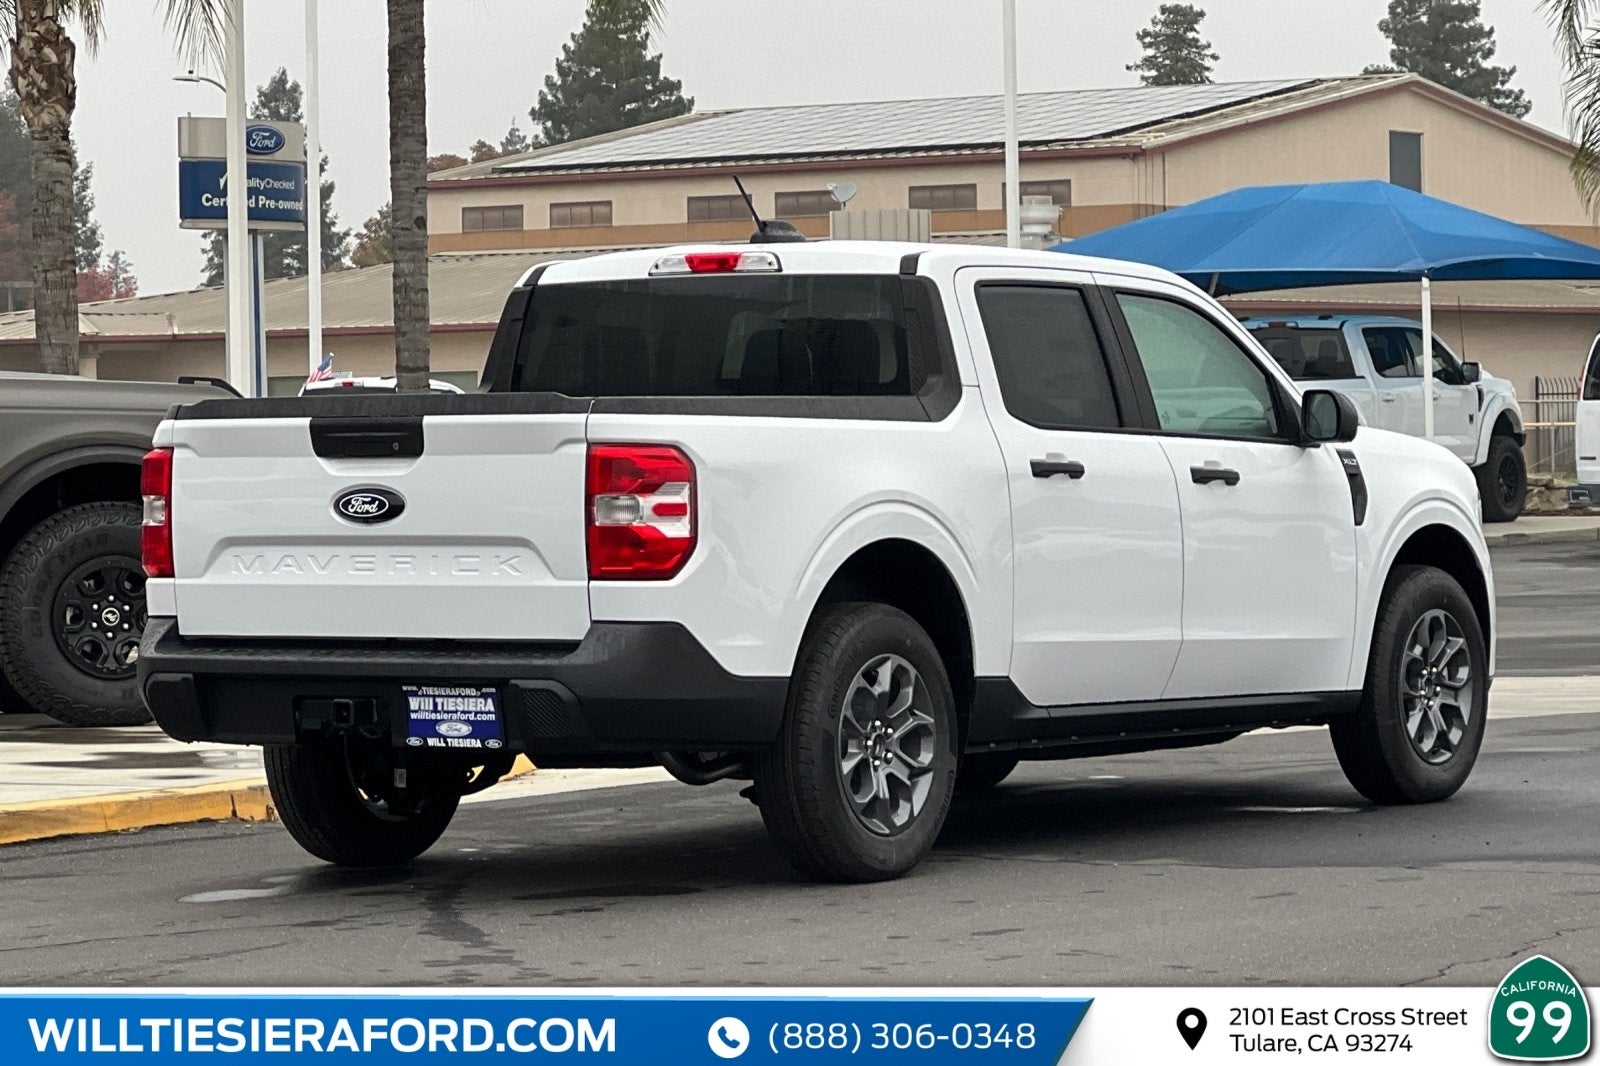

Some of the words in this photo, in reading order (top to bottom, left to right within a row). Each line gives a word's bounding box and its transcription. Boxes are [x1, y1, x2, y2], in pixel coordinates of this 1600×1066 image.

[249, 131, 276, 148] Ford
[258, 195, 303, 211] Pre-owned
[1343, 457, 1358, 466] XLT
[347, 496, 379, 514] Ford
[231, 554, 522, 576] MAVERICK
[435, 698, 495, 712] TIESIERA
[410, 710, 496, 721] willtiesieraford.com
[427, 737, 447, 747] WILL
[446, 738, 482, 748] TIESIERA
